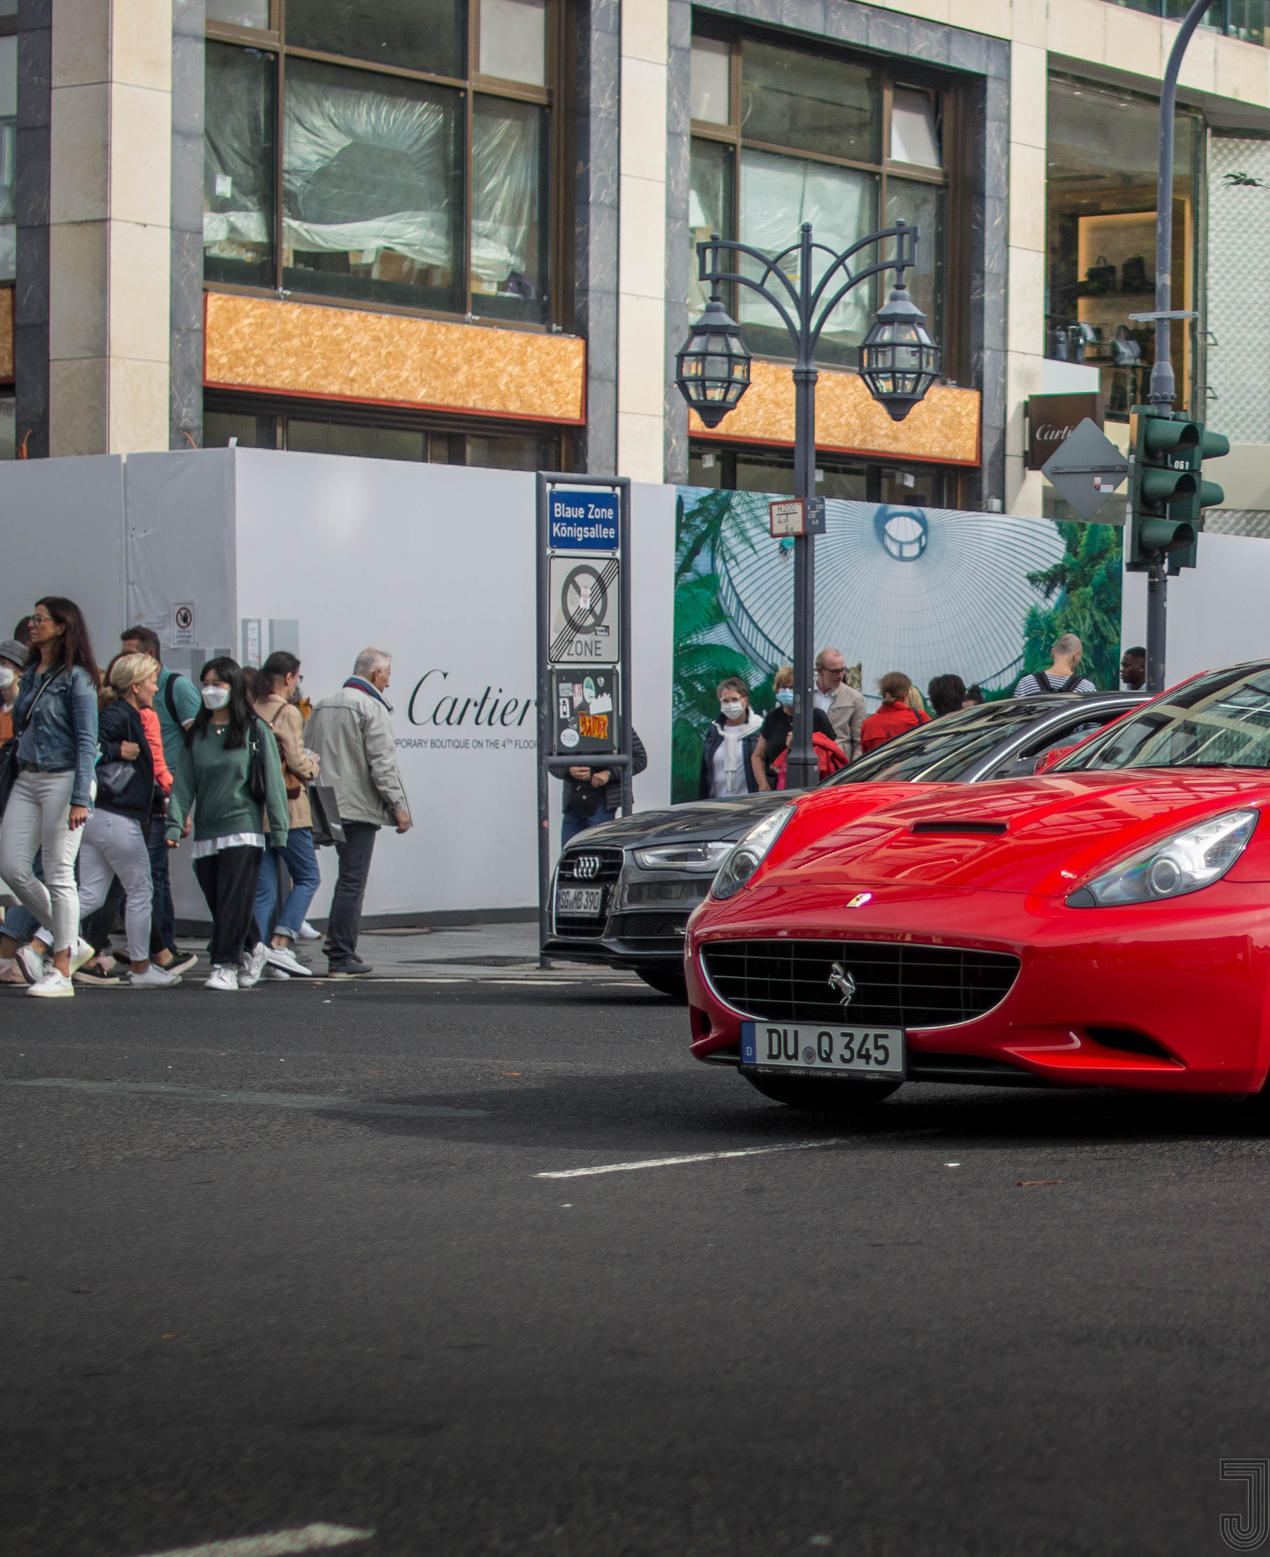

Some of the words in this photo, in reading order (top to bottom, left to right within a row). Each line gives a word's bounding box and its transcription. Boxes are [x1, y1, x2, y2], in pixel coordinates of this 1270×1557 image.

[1035, 423, 1073, 441] Carti
[1173, 460, 1190, 470] 061
[554, 502, 585, 518] Blaue
[587, 503, 614, 519] Zone
[552, 522, 616, 542] Königsallee
[567, 640, 602, 657] ZONE
[408, 668, 538, 727] Cartier
[394, 738, 429, 749] PORARY
[430, 738, 470, 750] BOUTIQUE
[473, 739, 484, 749] ON
[486, 739, 499, 749] THE
[746, 1046, 752, 1055] D
[766, 1028, 799, 1061] DU
[817, 1031, 833, 1063] Q
[839, 1032, 889, 1066] 345
